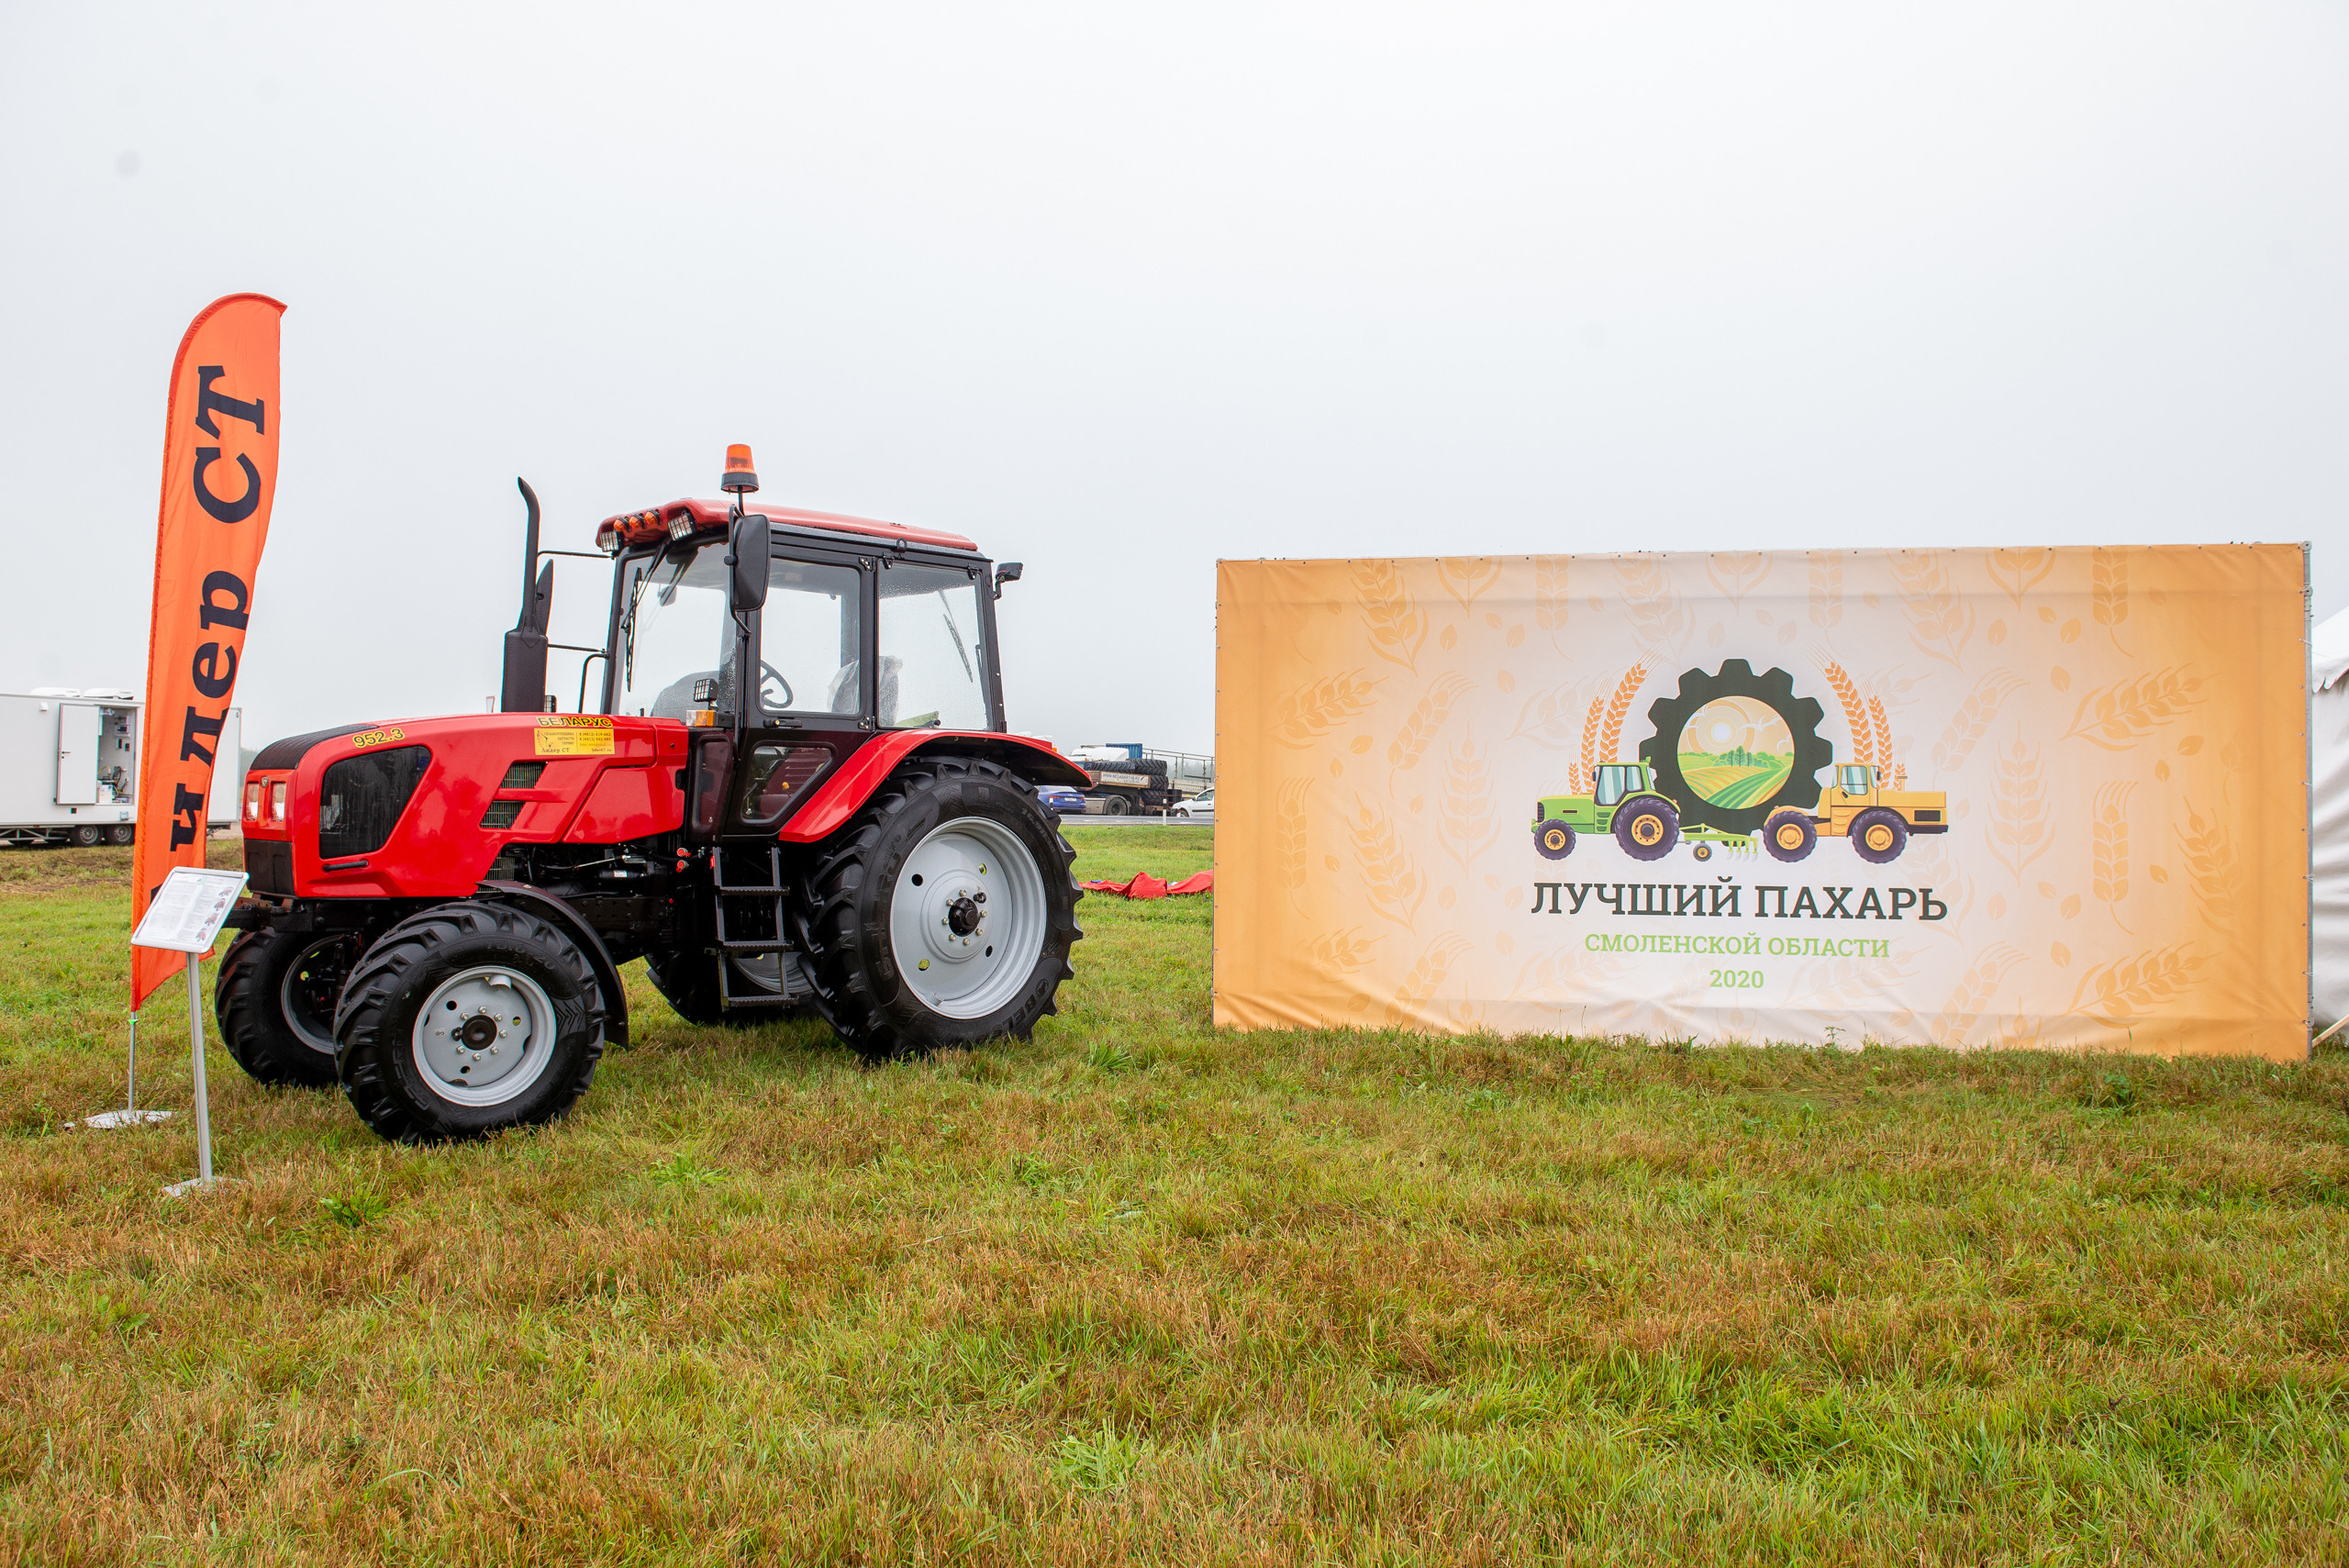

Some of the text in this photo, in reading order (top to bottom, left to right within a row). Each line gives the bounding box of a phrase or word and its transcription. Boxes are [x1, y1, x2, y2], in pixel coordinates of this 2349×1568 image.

[193, 364, 265, 524] СТ
[537, 717, 613, 728] БЕЛАРУС
[150, 571, 250, 903] идер
[352, 728, 405, 748] 952.3
[1531, 876, 1948, 921] ЛУЧШИЙ ПАХАРЬ
[1585, 932, 1890, 958] СМОЛЕНСКОЙ ОБЛАСТИ
[1709, 970, 1765, 989] 2020
